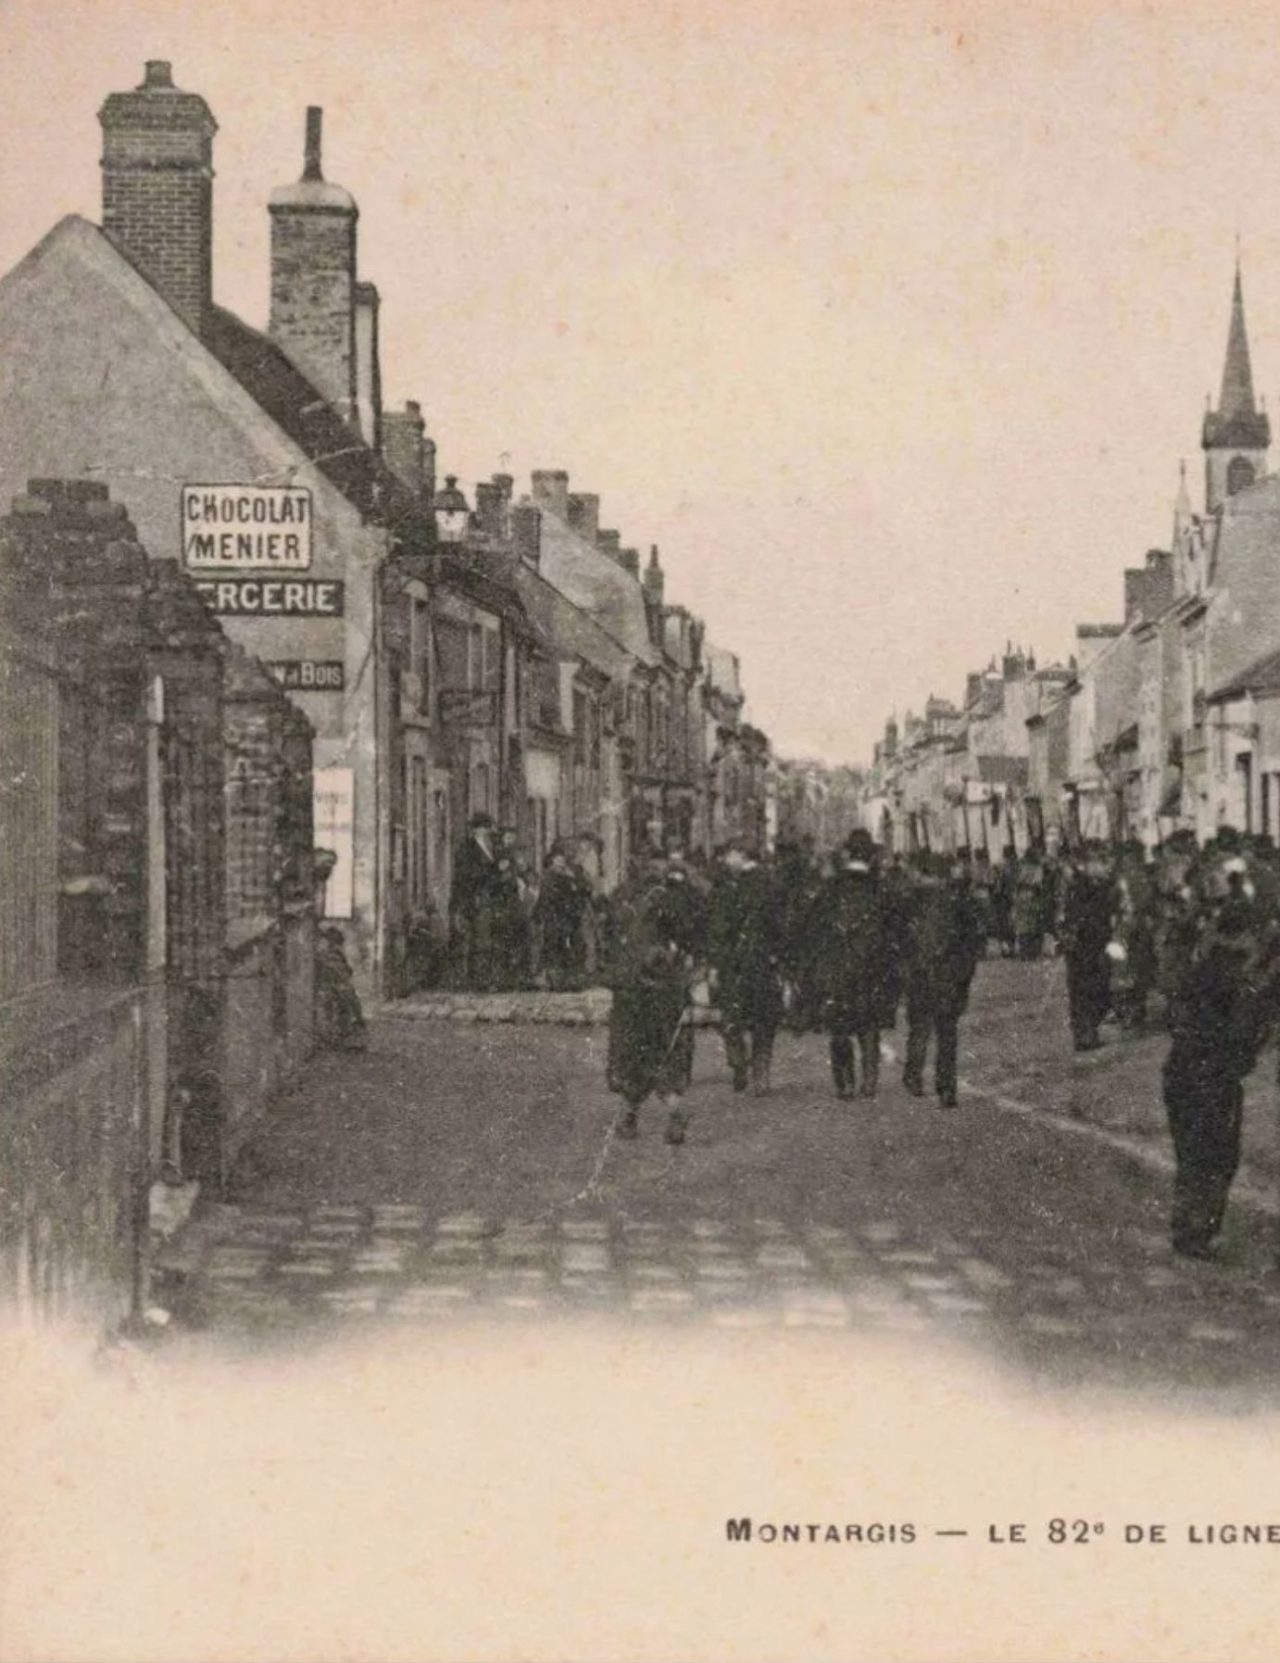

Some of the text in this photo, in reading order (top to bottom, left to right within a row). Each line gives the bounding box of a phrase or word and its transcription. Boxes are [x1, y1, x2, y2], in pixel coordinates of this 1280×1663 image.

[187, 494, 308, 523] CHOCOLAT
[188, 532, 301, 560] MENIER
[196, 582, 336, 612] ERCERIE
